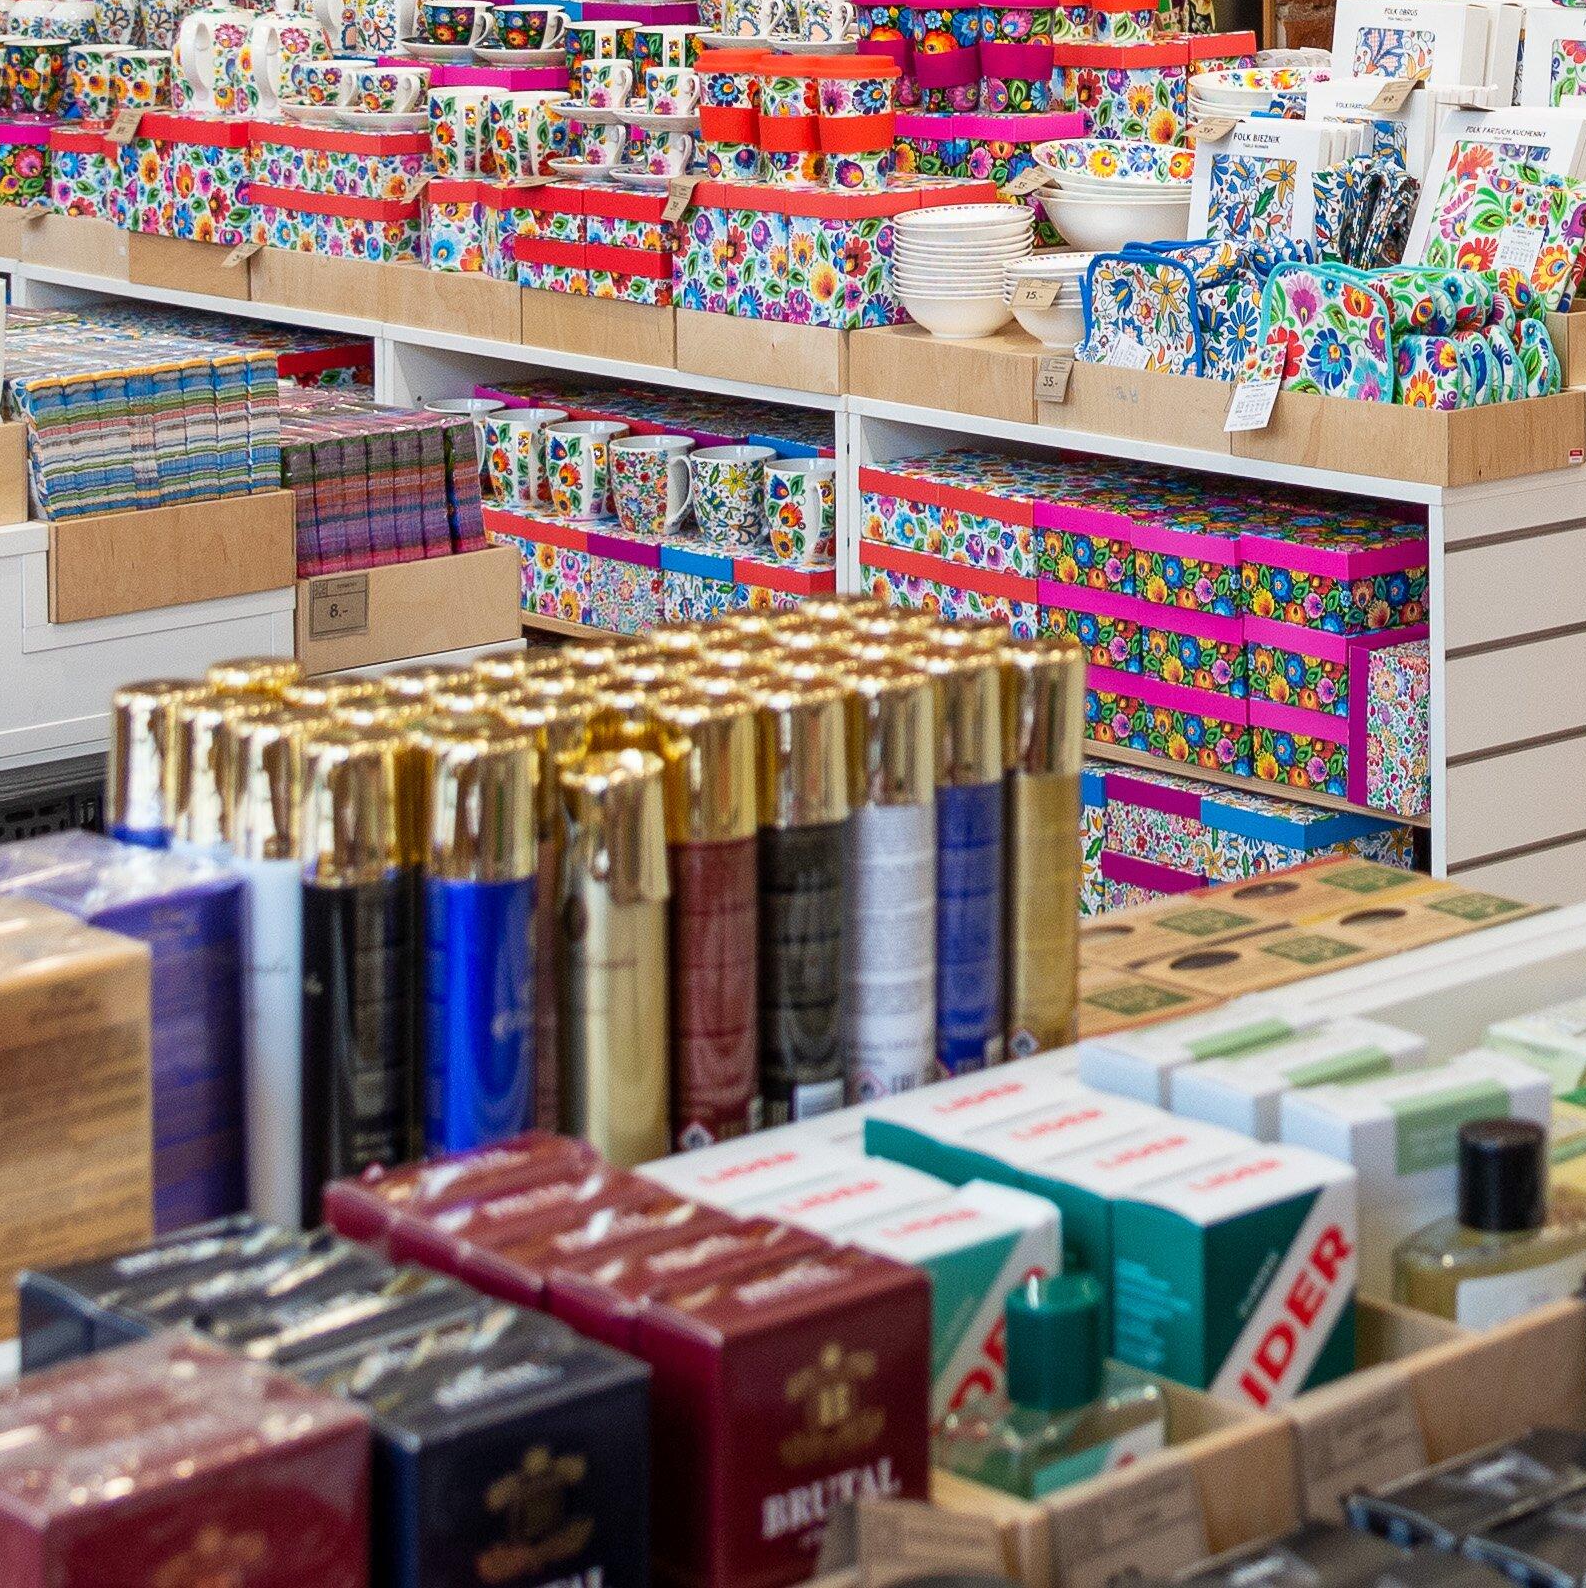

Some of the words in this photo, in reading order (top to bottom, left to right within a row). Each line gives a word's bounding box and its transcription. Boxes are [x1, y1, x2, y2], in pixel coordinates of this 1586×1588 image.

[1233, 132, 1251, 142] FOLK
[328, 603, 349, 618] 8.-
[1238, 1223, 1353, 1412] IDER
